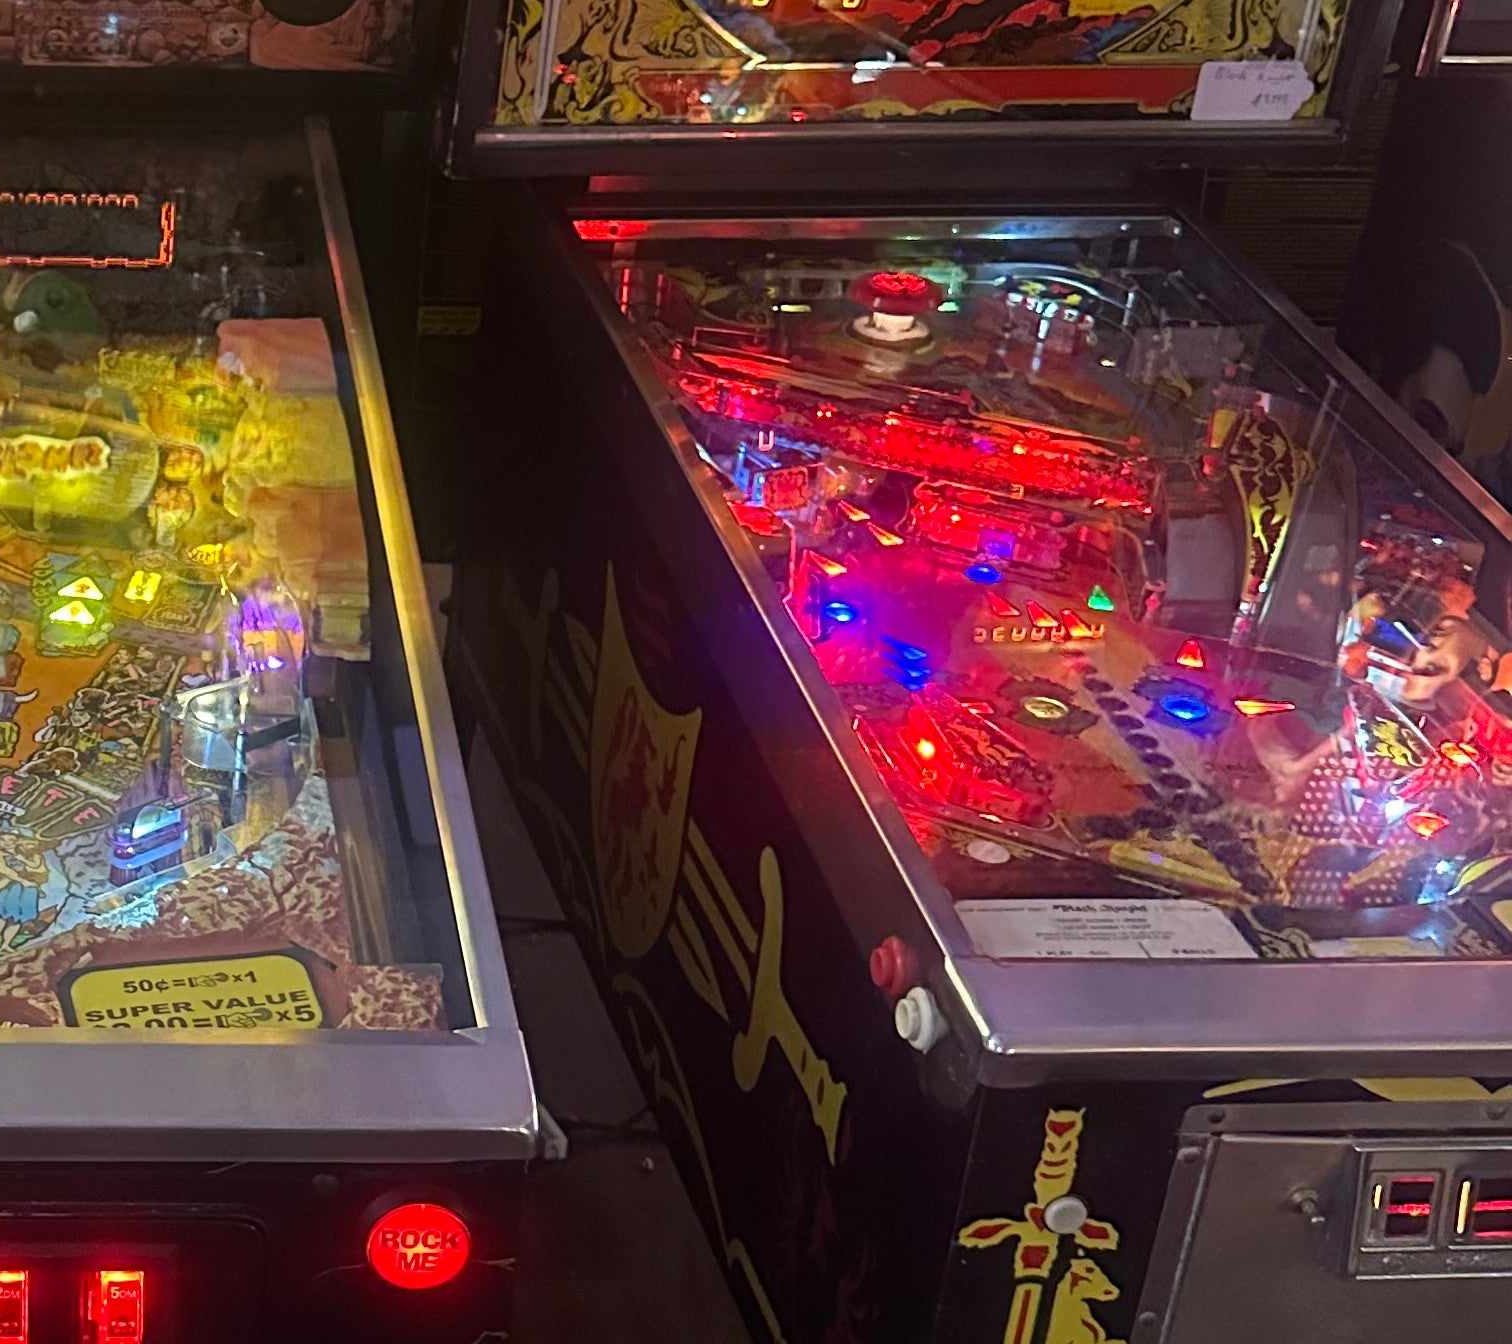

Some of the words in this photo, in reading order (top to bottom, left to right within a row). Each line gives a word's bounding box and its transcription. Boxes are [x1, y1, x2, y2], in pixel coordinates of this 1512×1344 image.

[85, 1001, 194, 1022] SUPER
[203, 990, 310, 1012] VALUE
[380, 1228, 462, 1250] ROCK
[396, 1251, 441, 1273] ME
